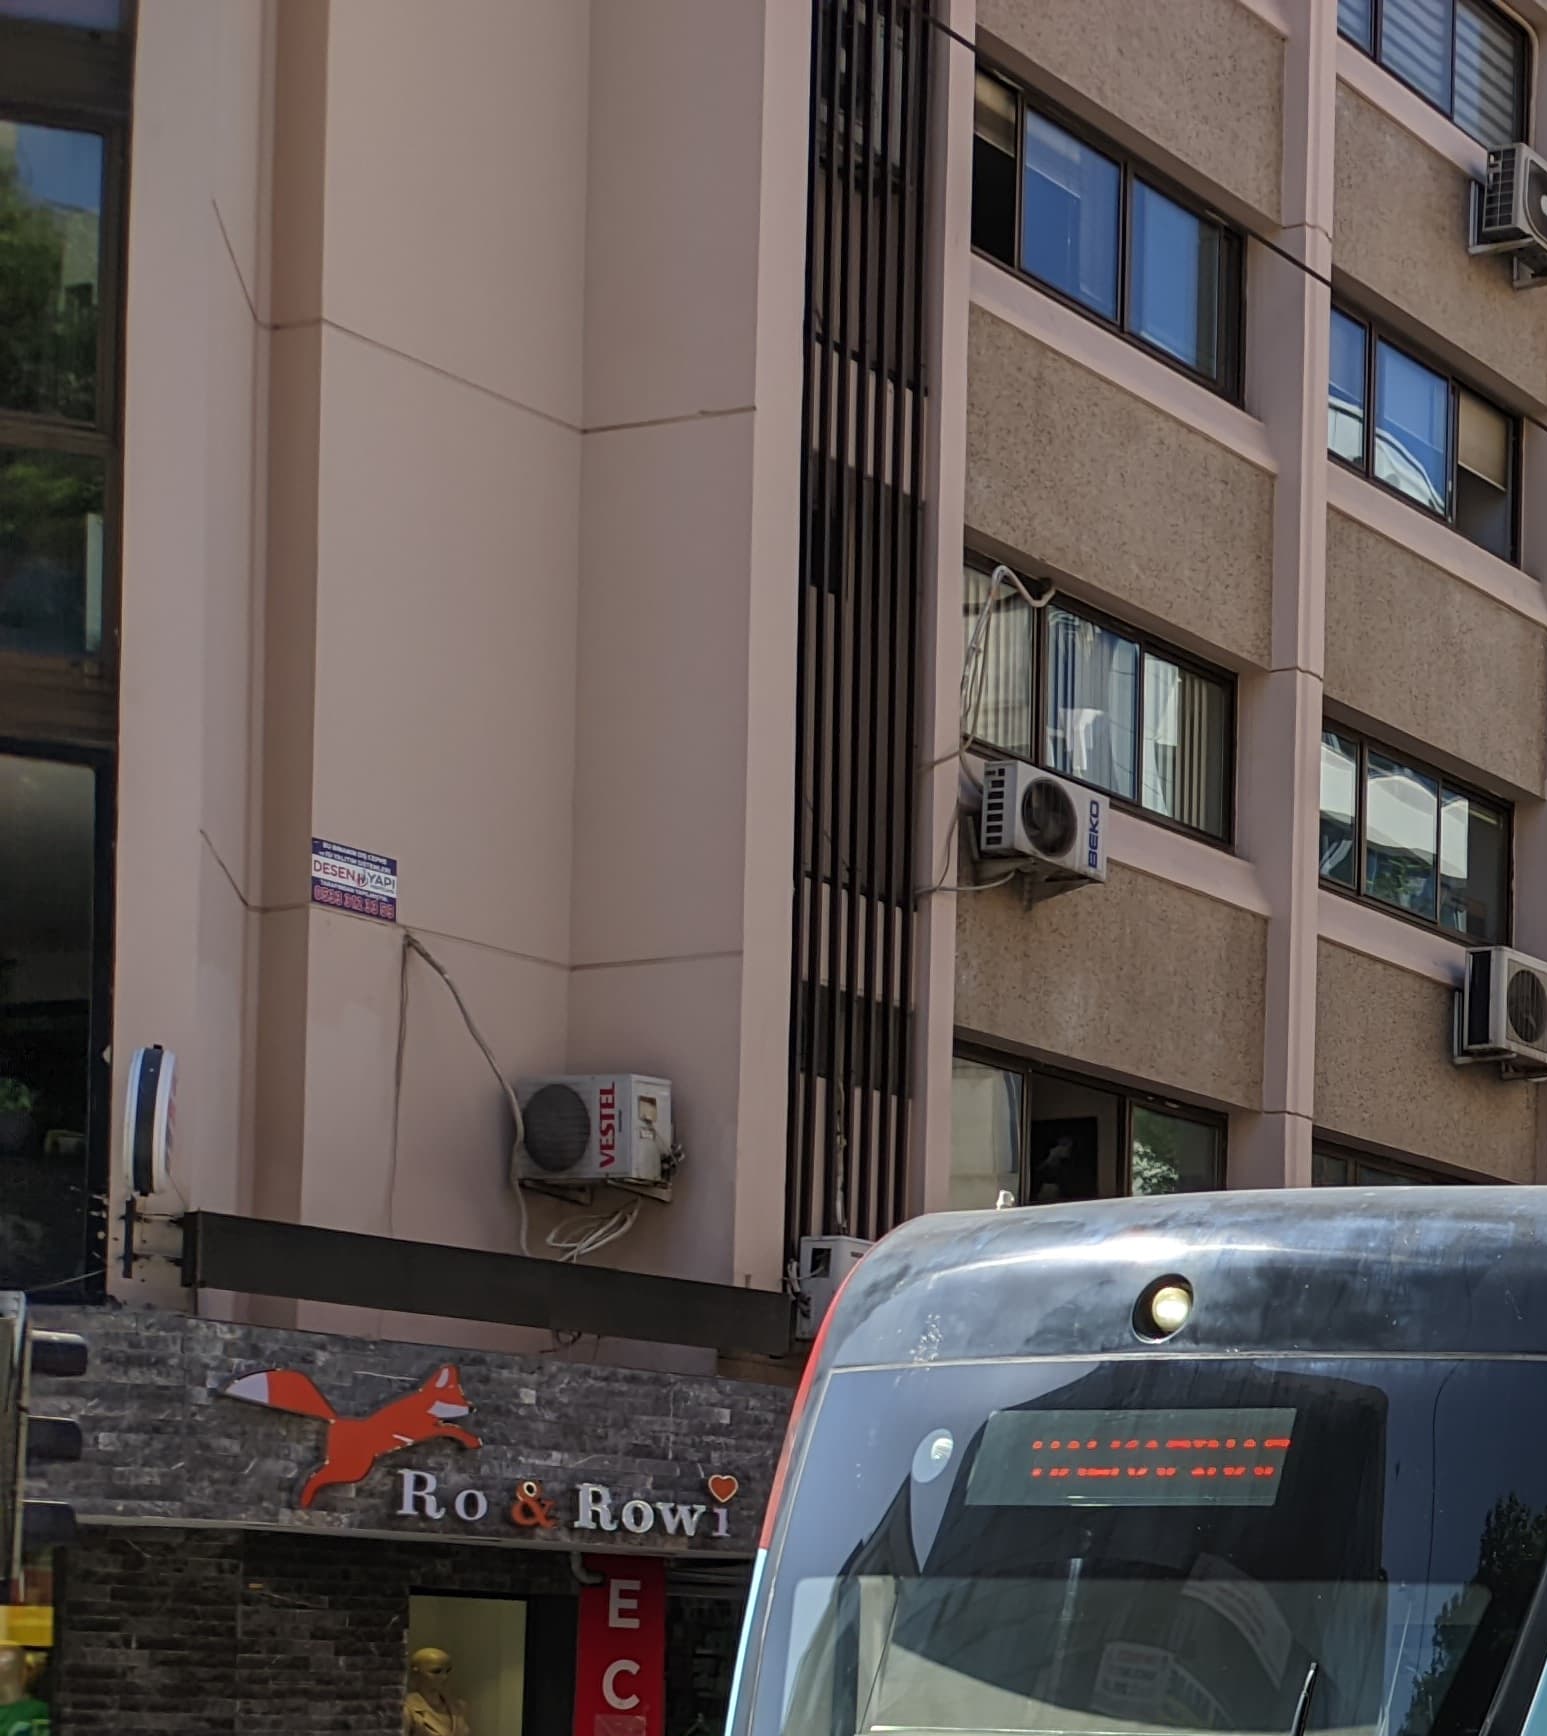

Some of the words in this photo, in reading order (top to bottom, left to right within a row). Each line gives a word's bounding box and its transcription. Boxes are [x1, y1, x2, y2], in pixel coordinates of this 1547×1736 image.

[1088, 799, 1100, 869] BEKO
[313, 860, 356, 881] DESEN
[367, 872, 396, 889] YAPI
[599, 1081, 616, 1168] VESTEL
[397, 1469, 488, 1520] Ro
[511, 1480, 555, 1530] &
[574, 1480, 735, 1537] Rowi
